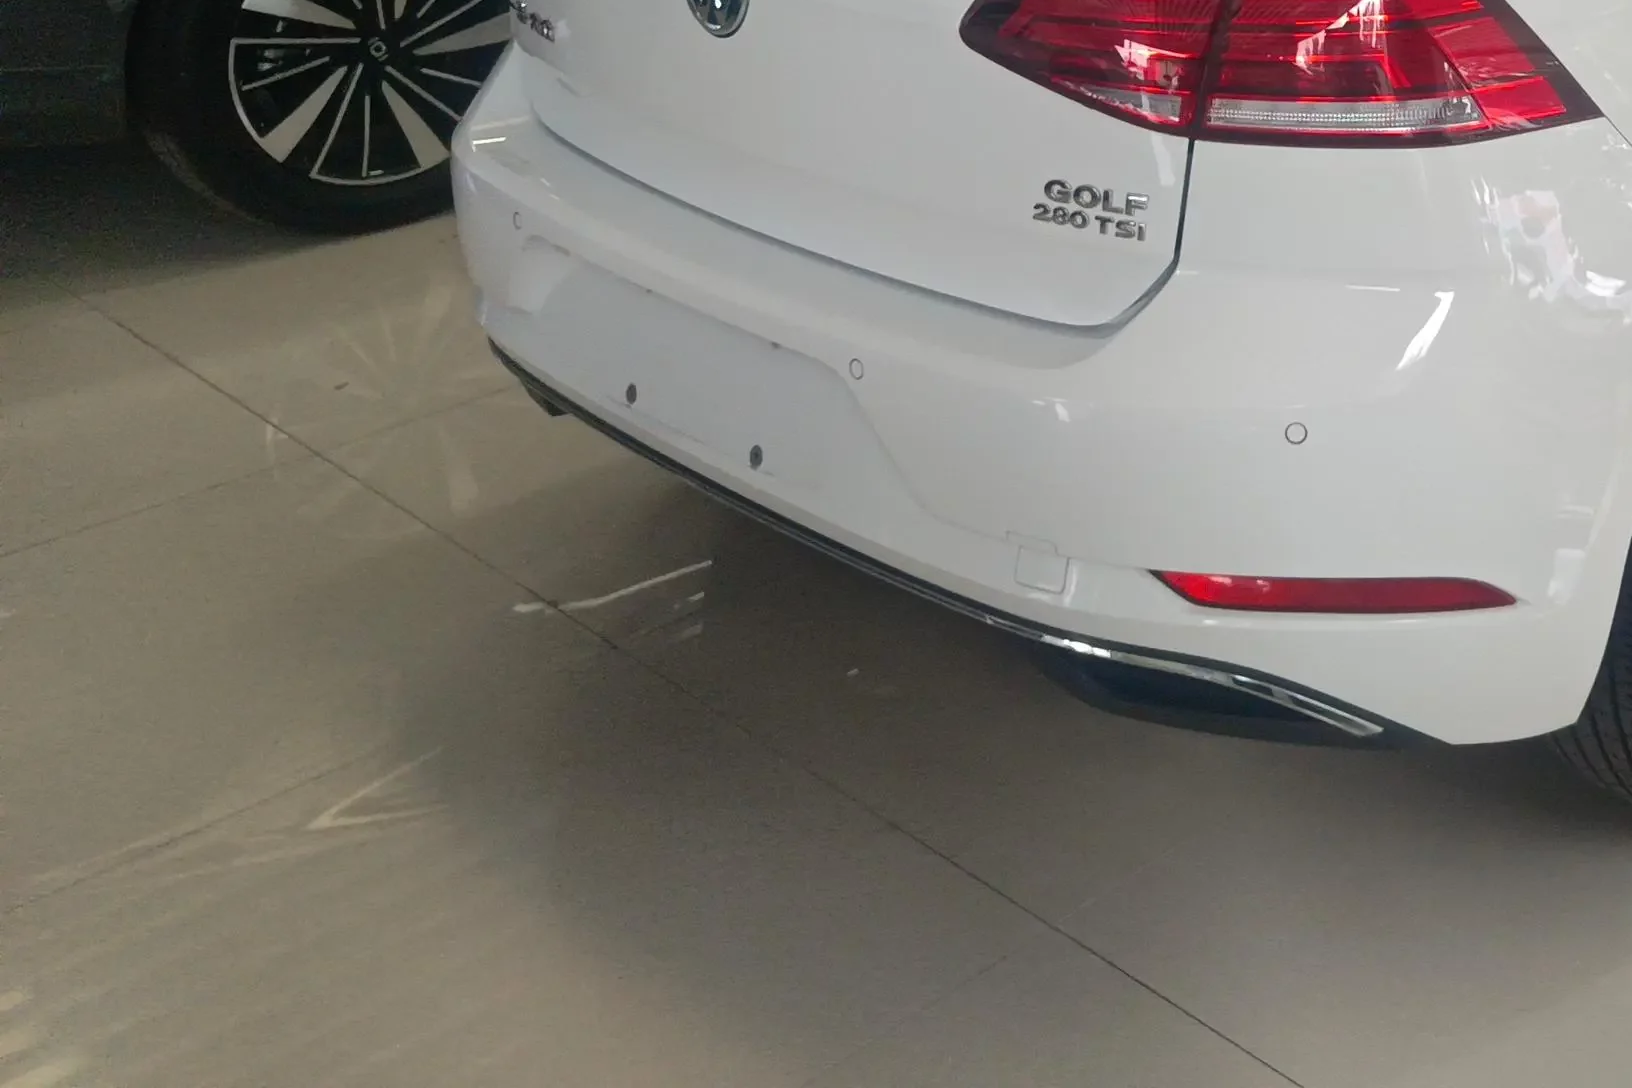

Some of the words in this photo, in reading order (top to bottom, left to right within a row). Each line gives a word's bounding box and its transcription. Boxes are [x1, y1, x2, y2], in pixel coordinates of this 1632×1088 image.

[1043, 178, 1149, 216] GOLF
[1032, 202, 1090, 229] 280
[1095, 215, 1147, 241] TSI
